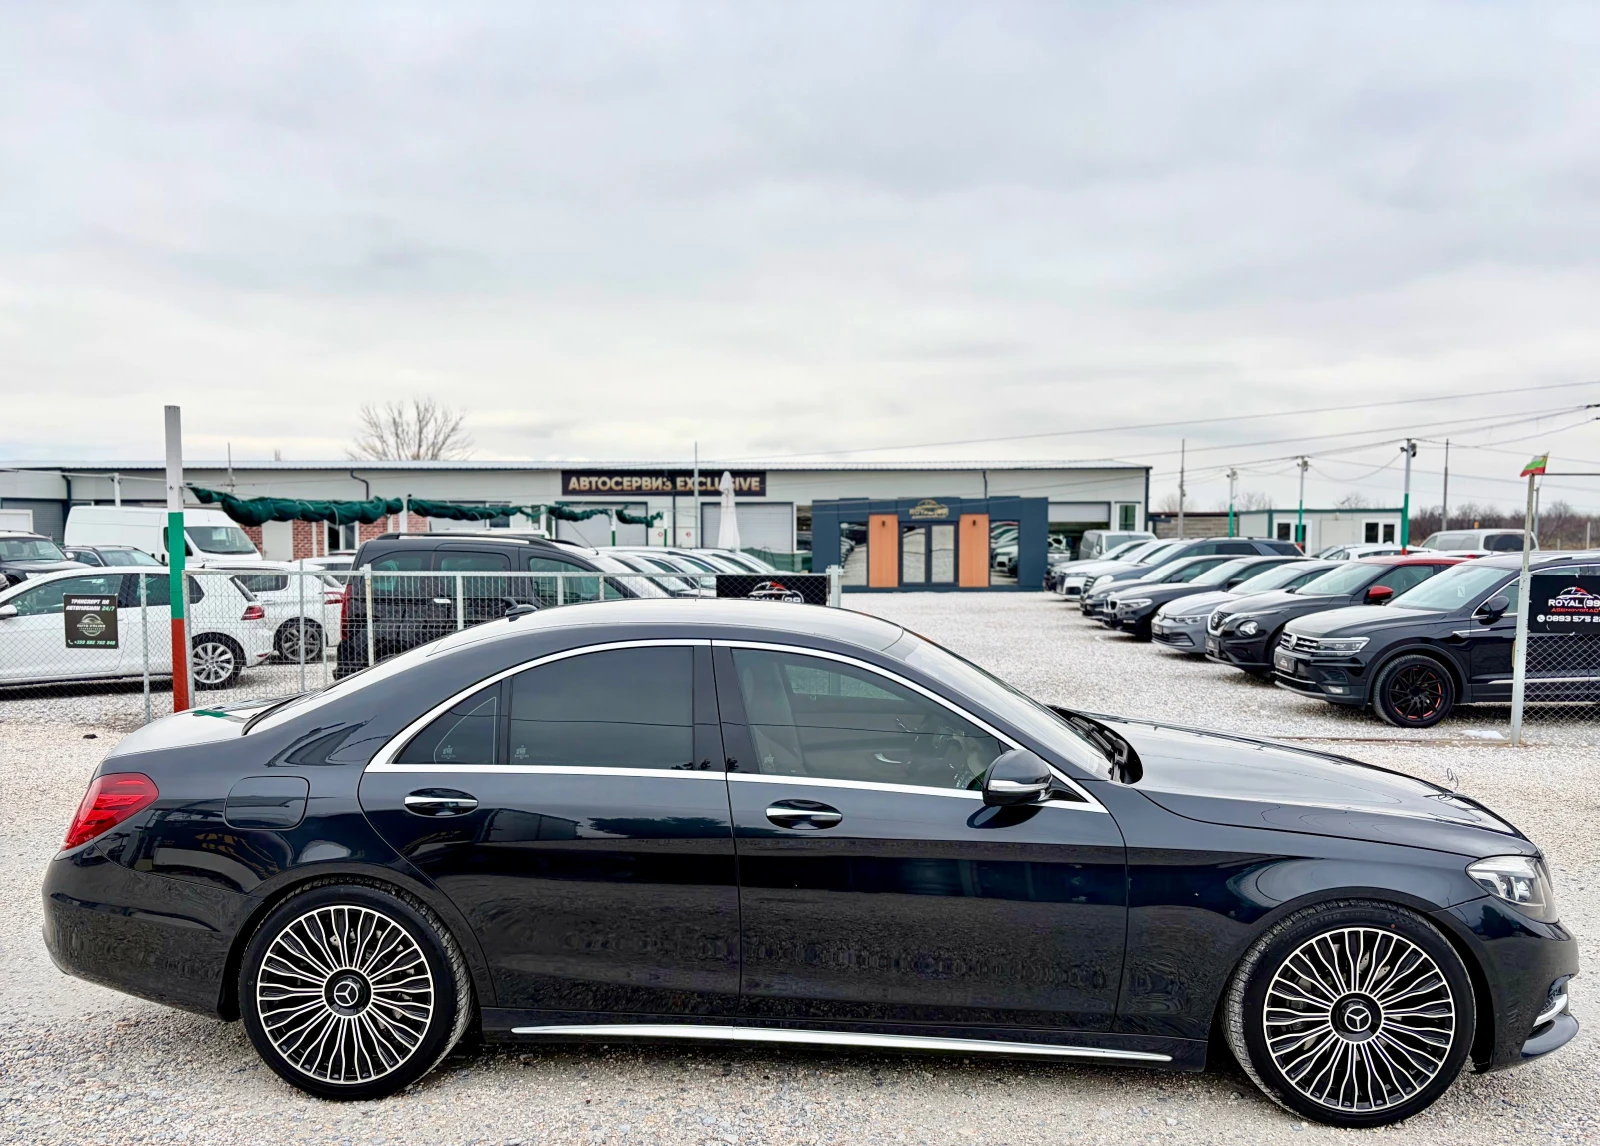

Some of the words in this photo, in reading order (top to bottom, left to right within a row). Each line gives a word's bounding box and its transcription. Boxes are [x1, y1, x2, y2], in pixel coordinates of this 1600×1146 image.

[568, 476, 673, 491] АВТОСЕРВИЗ
[676, 477, 760, 491] EXCLIVE
[1548, 599, 1583, 607] ROYAL
